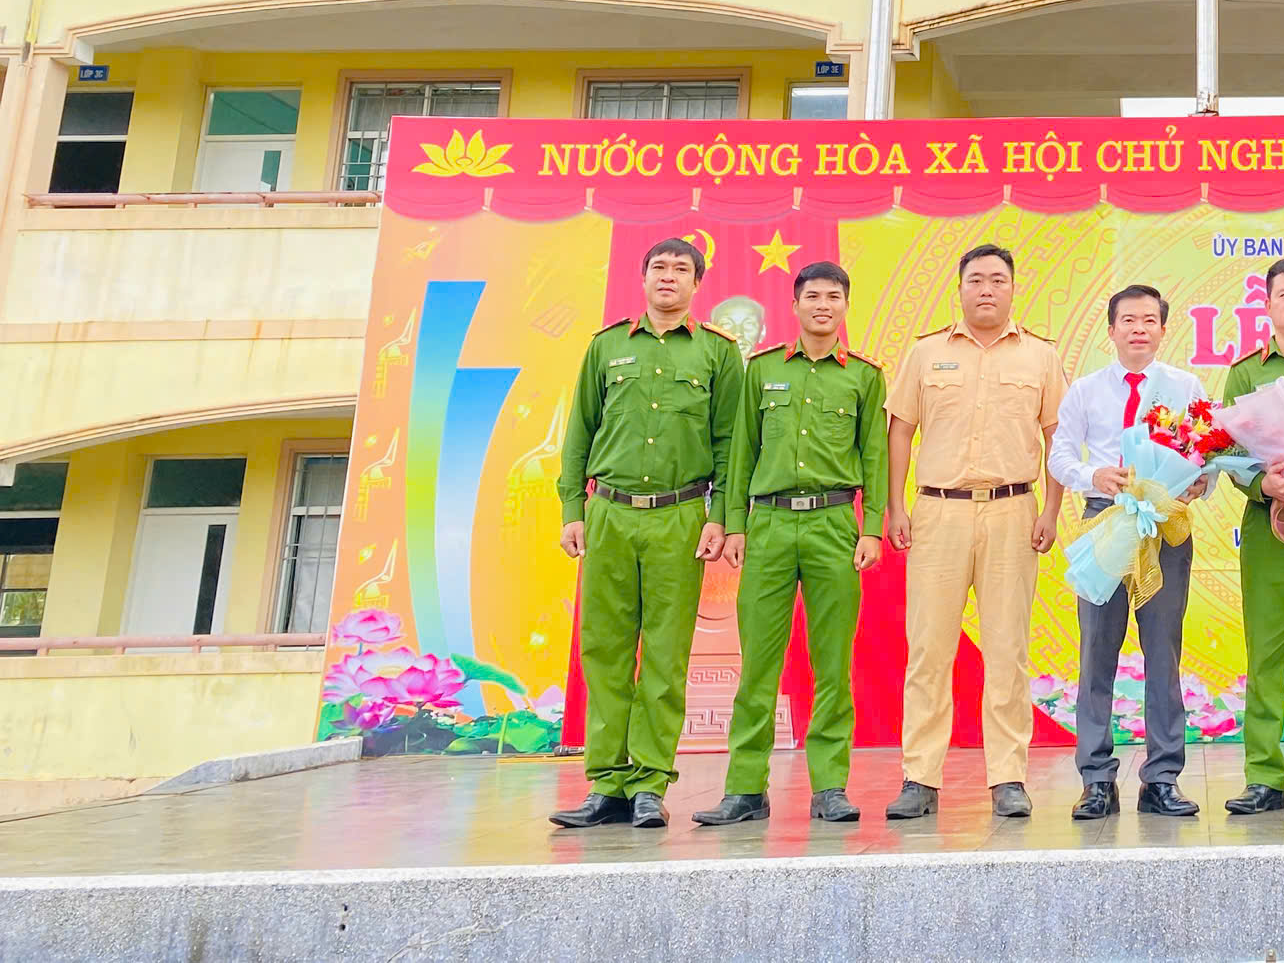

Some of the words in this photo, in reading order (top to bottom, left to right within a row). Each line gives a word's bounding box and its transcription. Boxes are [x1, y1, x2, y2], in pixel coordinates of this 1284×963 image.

[538, 132, 664, 176] NƯỚC
[675, 132, 802, 185] CỘNG
[813, 132, 911, 175] HÒA
[924, 134, 989, 174] XÃ
[1002, 131, 1083, 182] HỘI
[1096, 124, 1184, 172] CHỦ
[1213, 234, 1238, 256] ỦY
[1244, 238, 1283, 256] BAN
